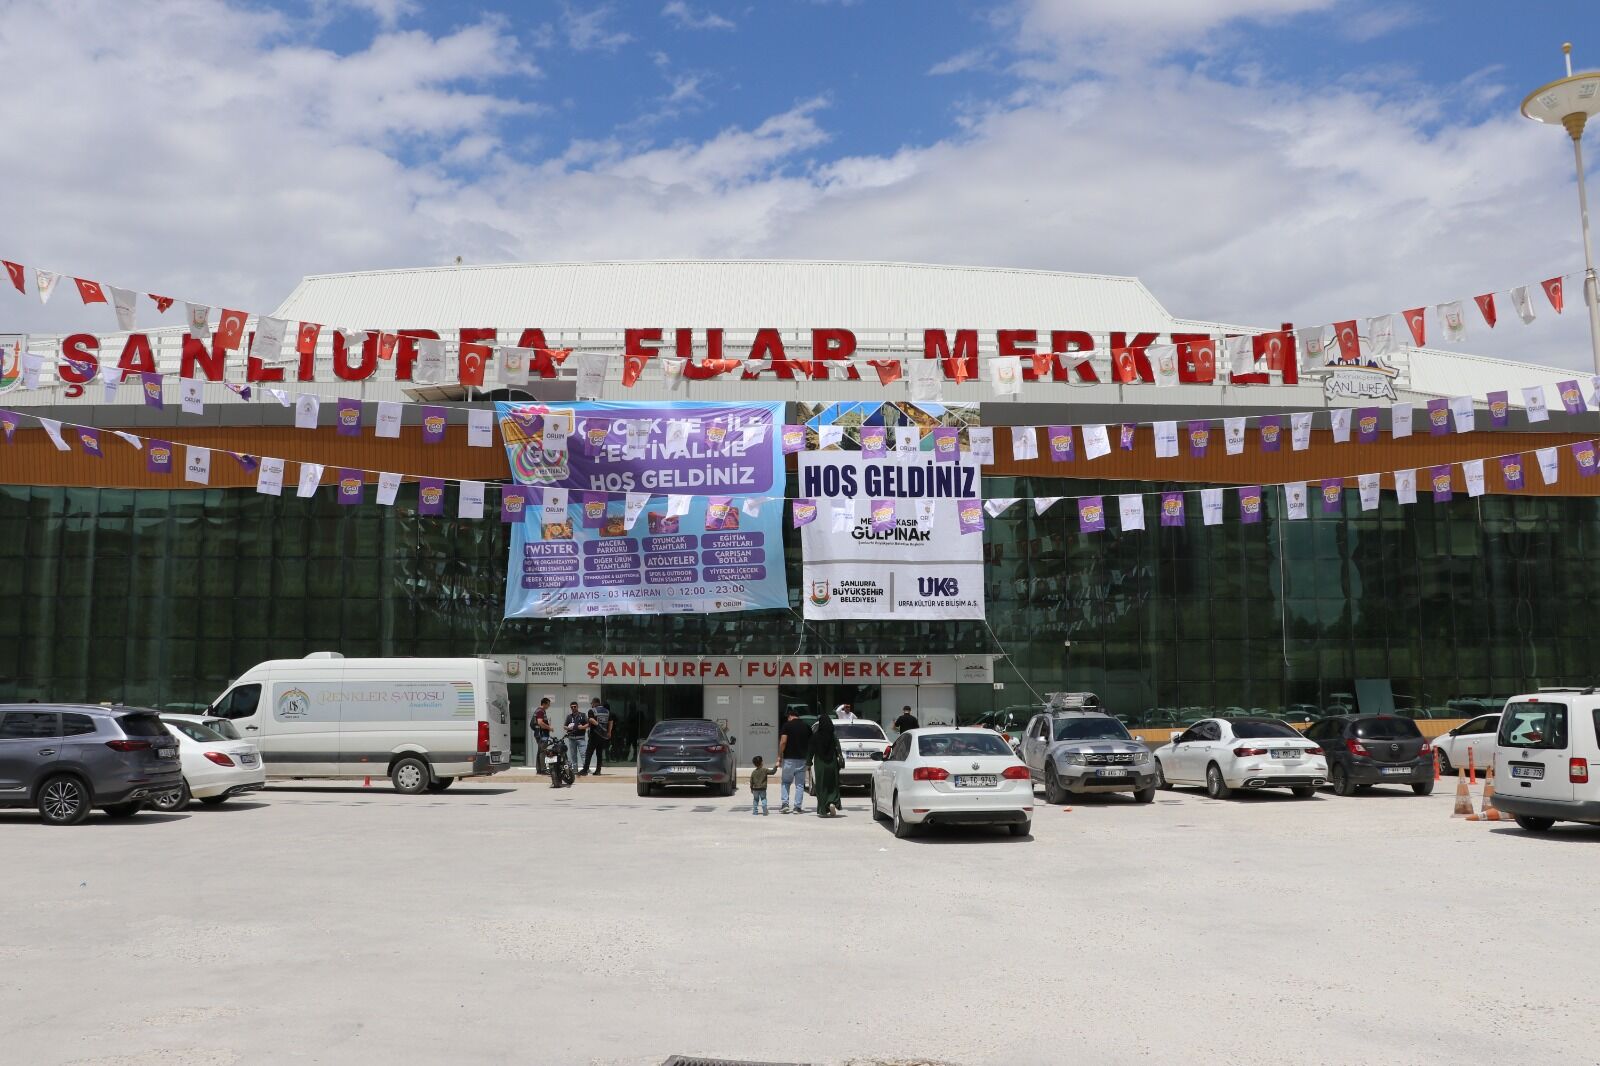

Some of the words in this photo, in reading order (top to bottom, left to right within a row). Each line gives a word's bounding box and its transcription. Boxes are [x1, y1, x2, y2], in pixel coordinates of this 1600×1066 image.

[624, 328, 861, 381] FUAR
[589, 472, 636, 493] HOŞ
[641, 463, 755, 489] GELDİNİZ
[804, 465, 858, 499] HOŞ
[864, 460, 976, 498] GELDİNİZ
[851, 526, 931, 542] GÜLPINAR
[526, 544, 574, 555] TWISTER
[648, 554, 696, 566] ATÖLYELER
[558, 592, 568, 600] 20
[570, 590, 600, 600] MAYIS
[622, 588, 661, 598] HAZİRAN
[680, 587, 706, 596] 12:00
[716, 585, 745, 594] 23:00
[832, 588, 884, 598] BÜYÜKŞEHİR
[918, 576, 960, 597] UKB
[914, 598, 936, 607] KÜLTÜR
[946, 599, 967, 608] BİLİŞİM
[587, 661, 730, 679] ŞANLIURFA
[747, 662, 813, 677] FUAR
[823, 661, 932, 677] MERKEZİ
[321, 690, 387, 704] RENKLER
[391, 690, 445, 704] ŞATOSU
